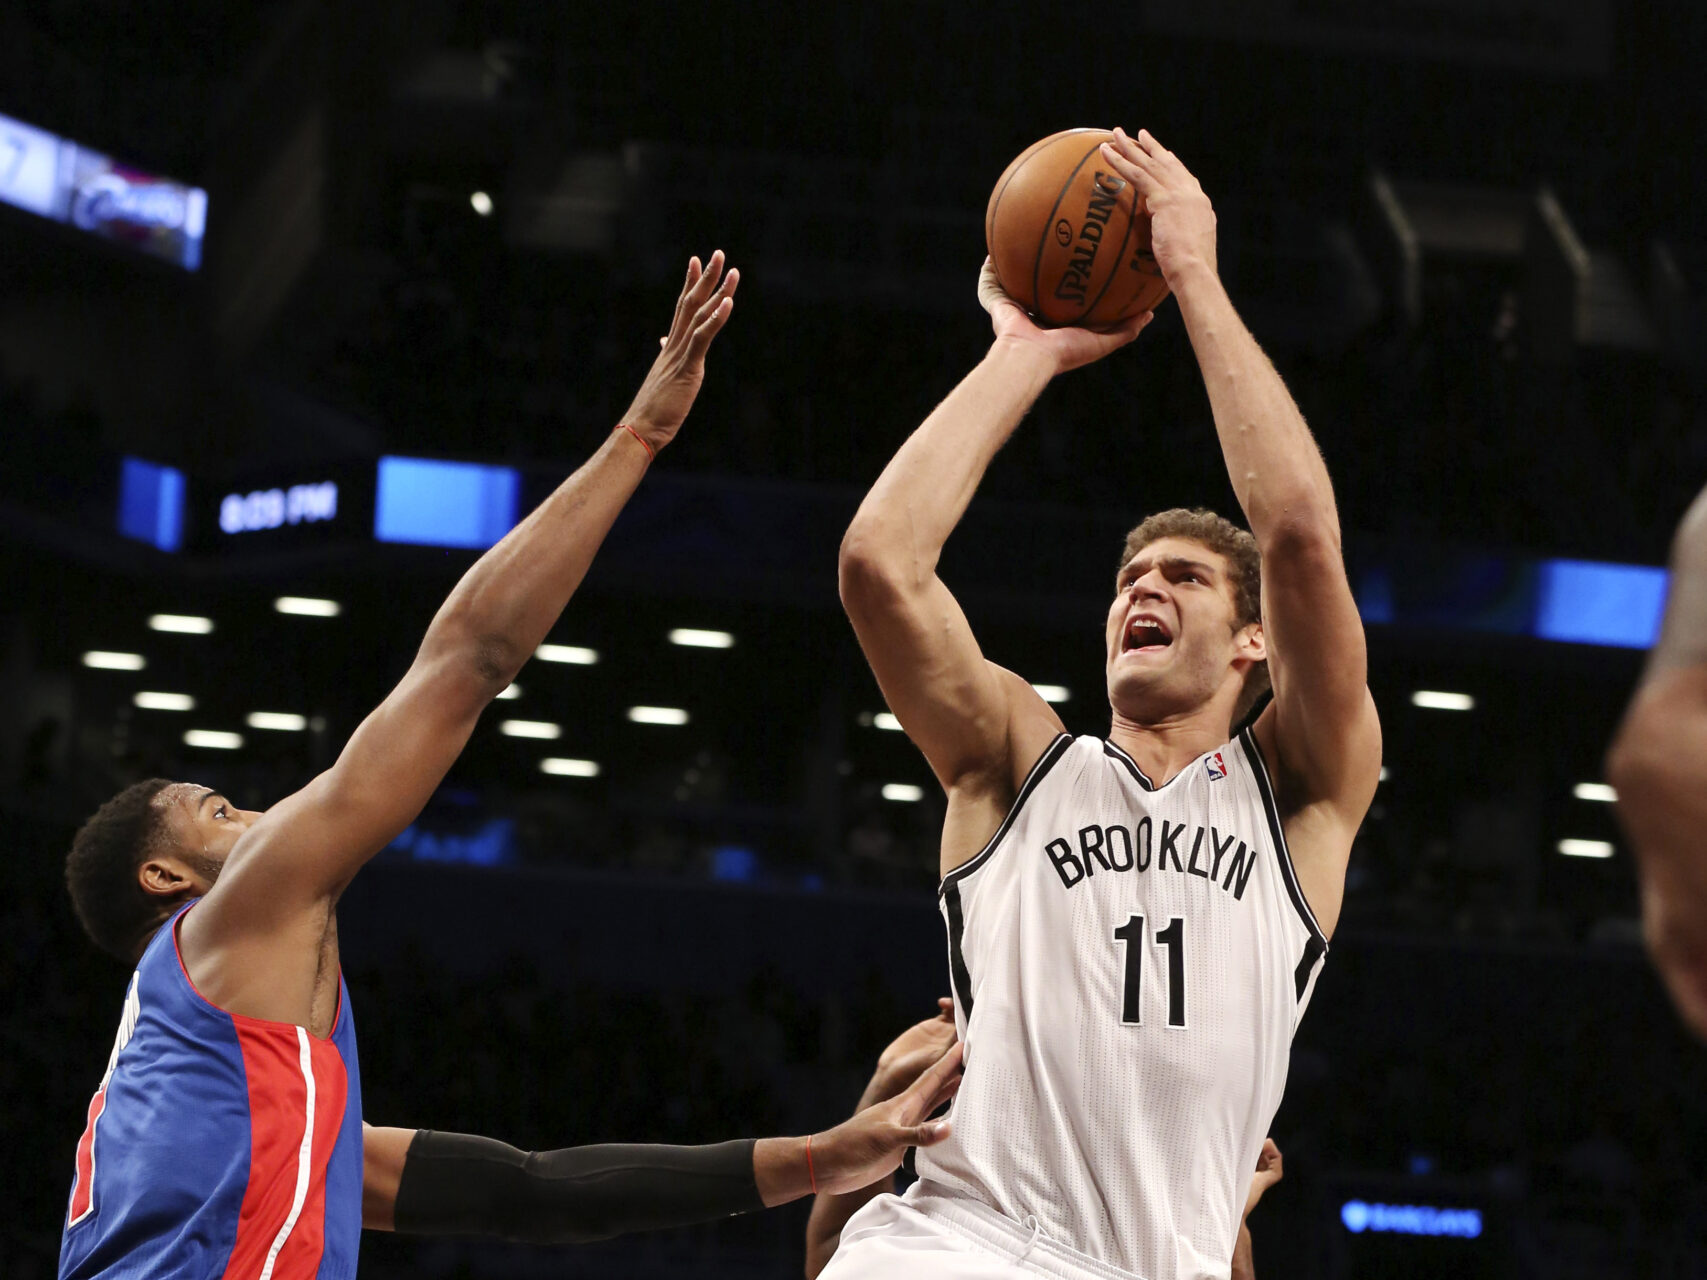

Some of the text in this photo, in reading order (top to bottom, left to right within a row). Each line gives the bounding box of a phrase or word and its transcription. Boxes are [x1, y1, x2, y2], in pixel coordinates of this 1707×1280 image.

[1054, 170, 1128, 307] SPALDING
[1044, 815, 1257, 901] BROOKLYN
[1112, 912, 1187, 1029] 11
